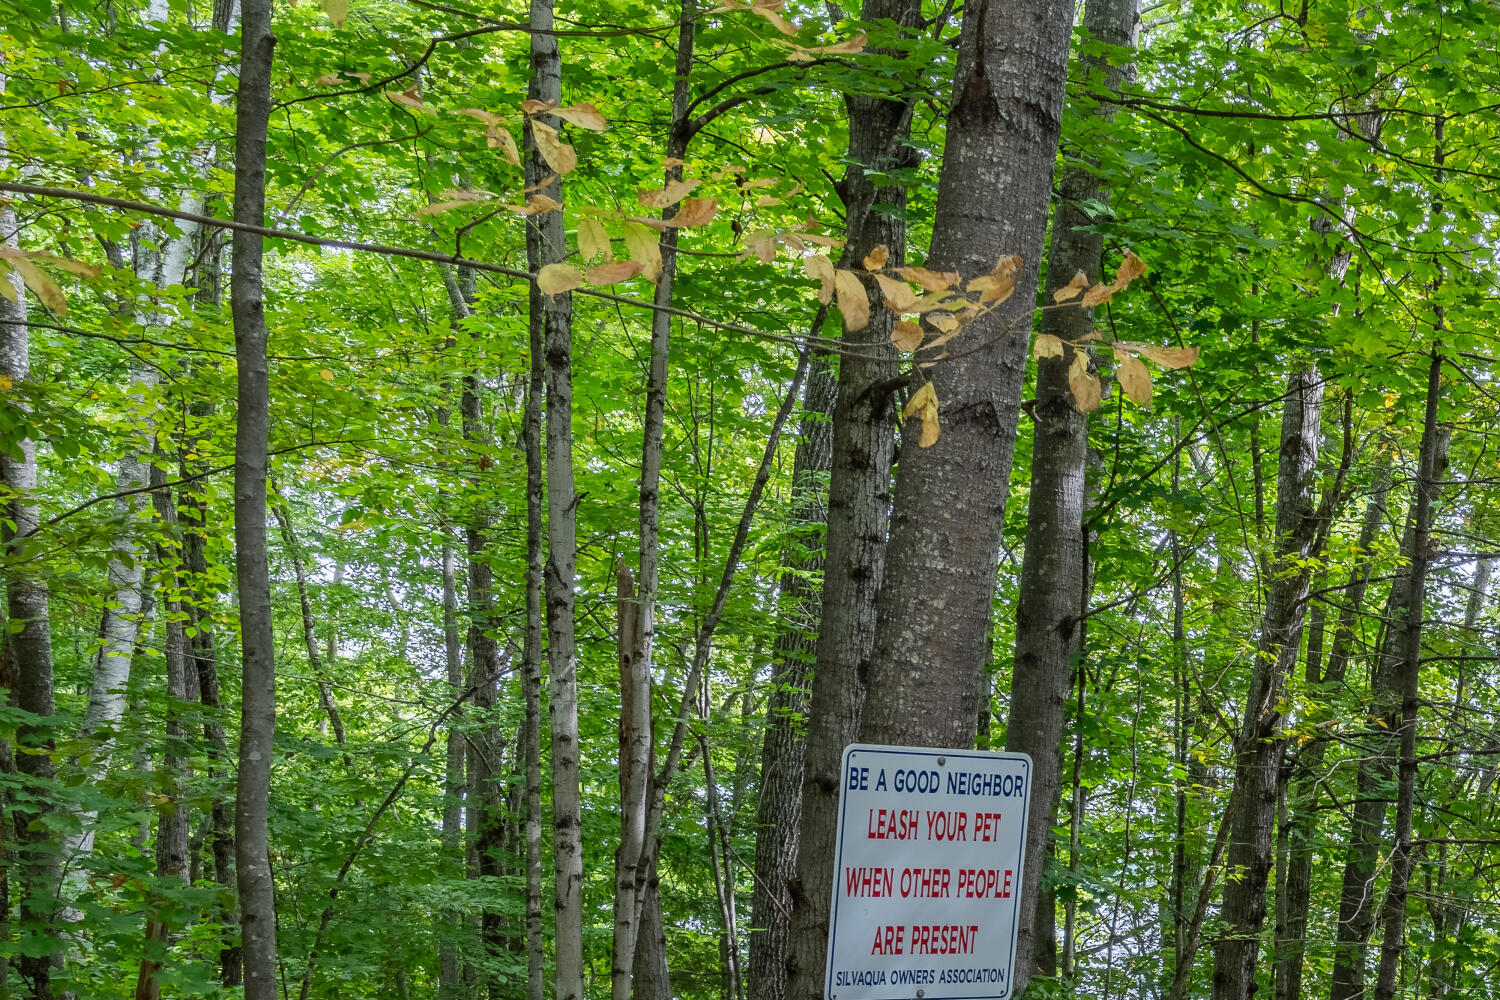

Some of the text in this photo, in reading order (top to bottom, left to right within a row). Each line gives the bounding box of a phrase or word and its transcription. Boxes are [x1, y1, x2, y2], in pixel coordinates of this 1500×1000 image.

[849, 767, 1023, 797] BE A GOOD NEIGHBOR
[868, 809, 1001, 842] LEASH YOUR PET
[846, 867, 1012, 899] WHEN OTHER PEOPLE
[871, 926, 978, 955] ARE PRESENT
[836, 968, 1005, 987] SILVAQUA OWNERS ASSOCIATION
